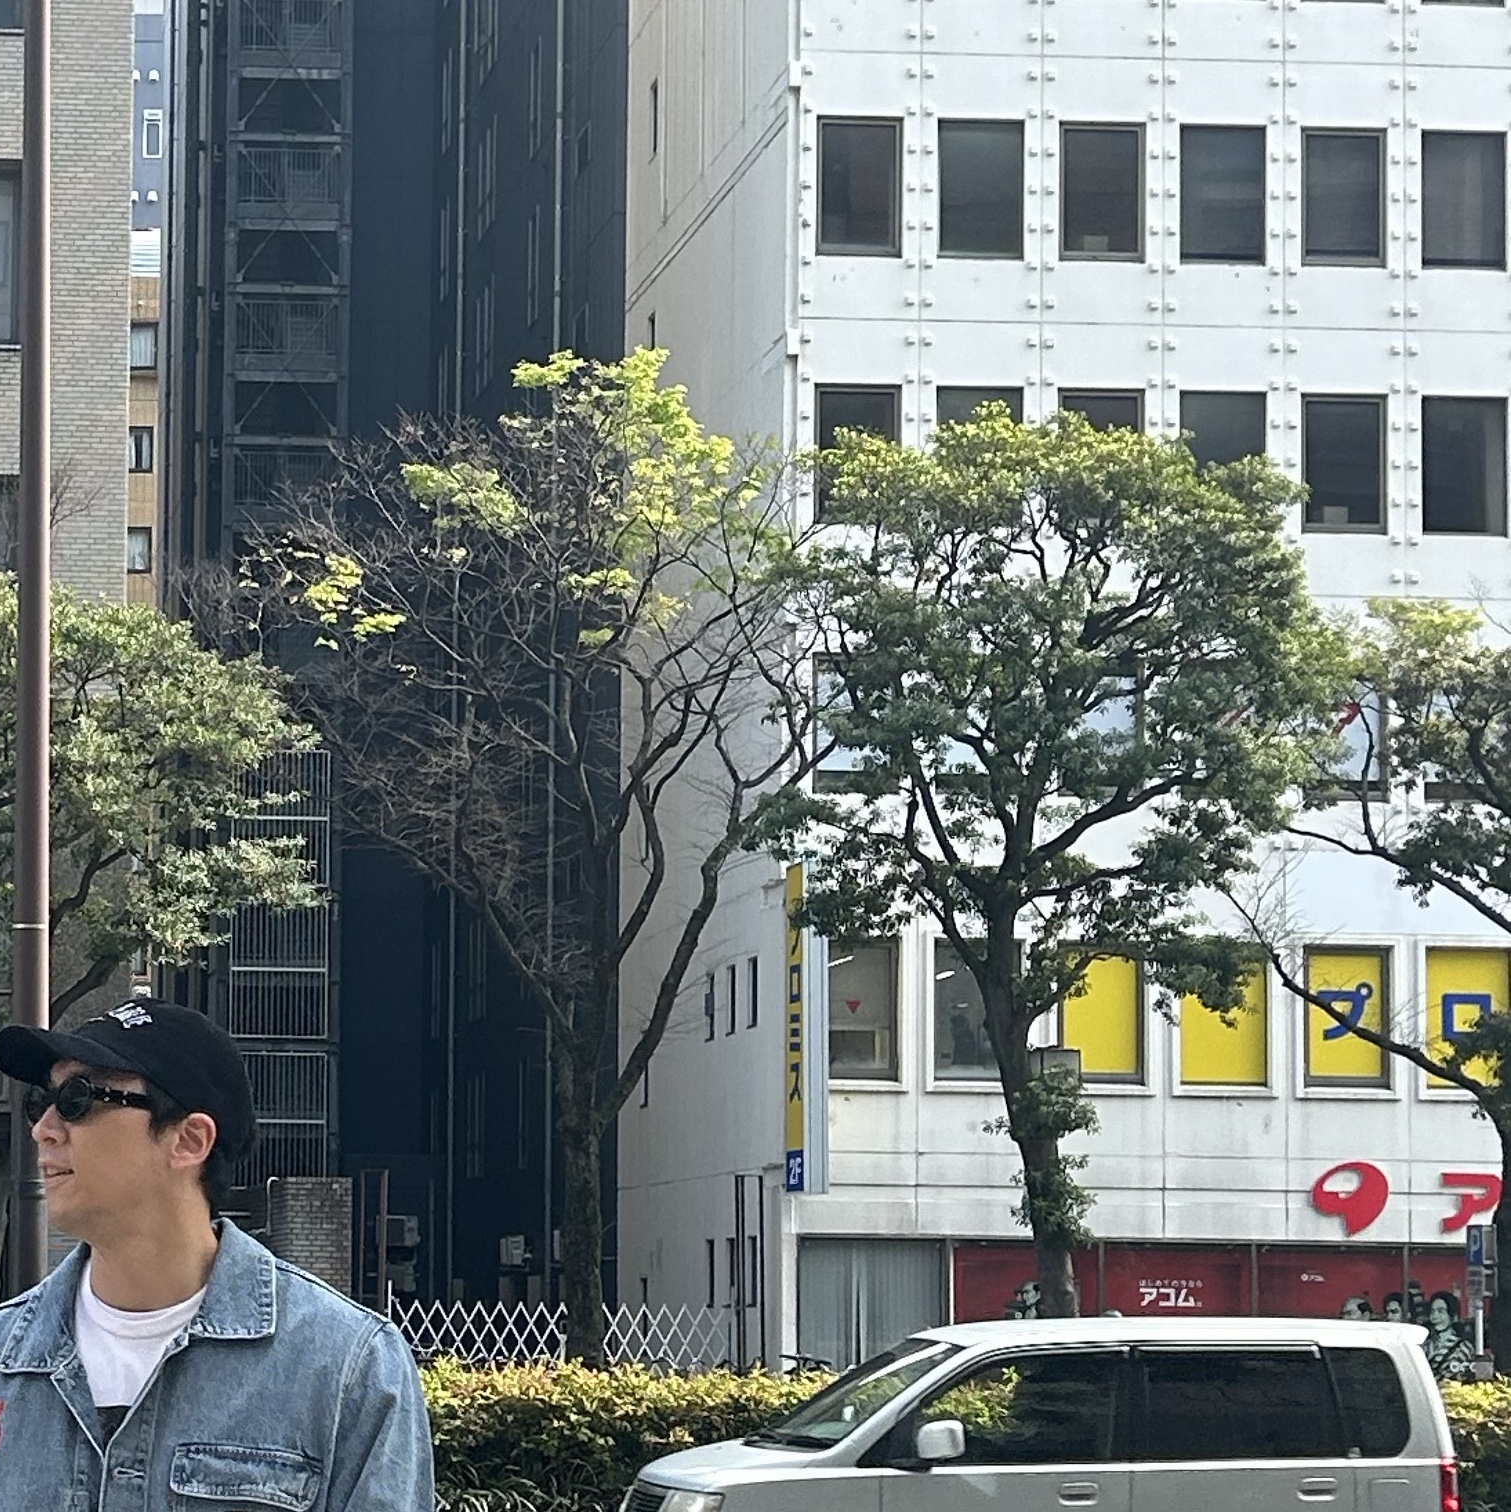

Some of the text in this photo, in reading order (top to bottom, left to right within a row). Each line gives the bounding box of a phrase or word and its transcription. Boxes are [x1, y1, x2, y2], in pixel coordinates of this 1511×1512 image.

[1440, 1172, 1502, 1233] ア
[1470, 1228, 1484, 1262] P
[1139, 1287, 1196, 1307] アコム
